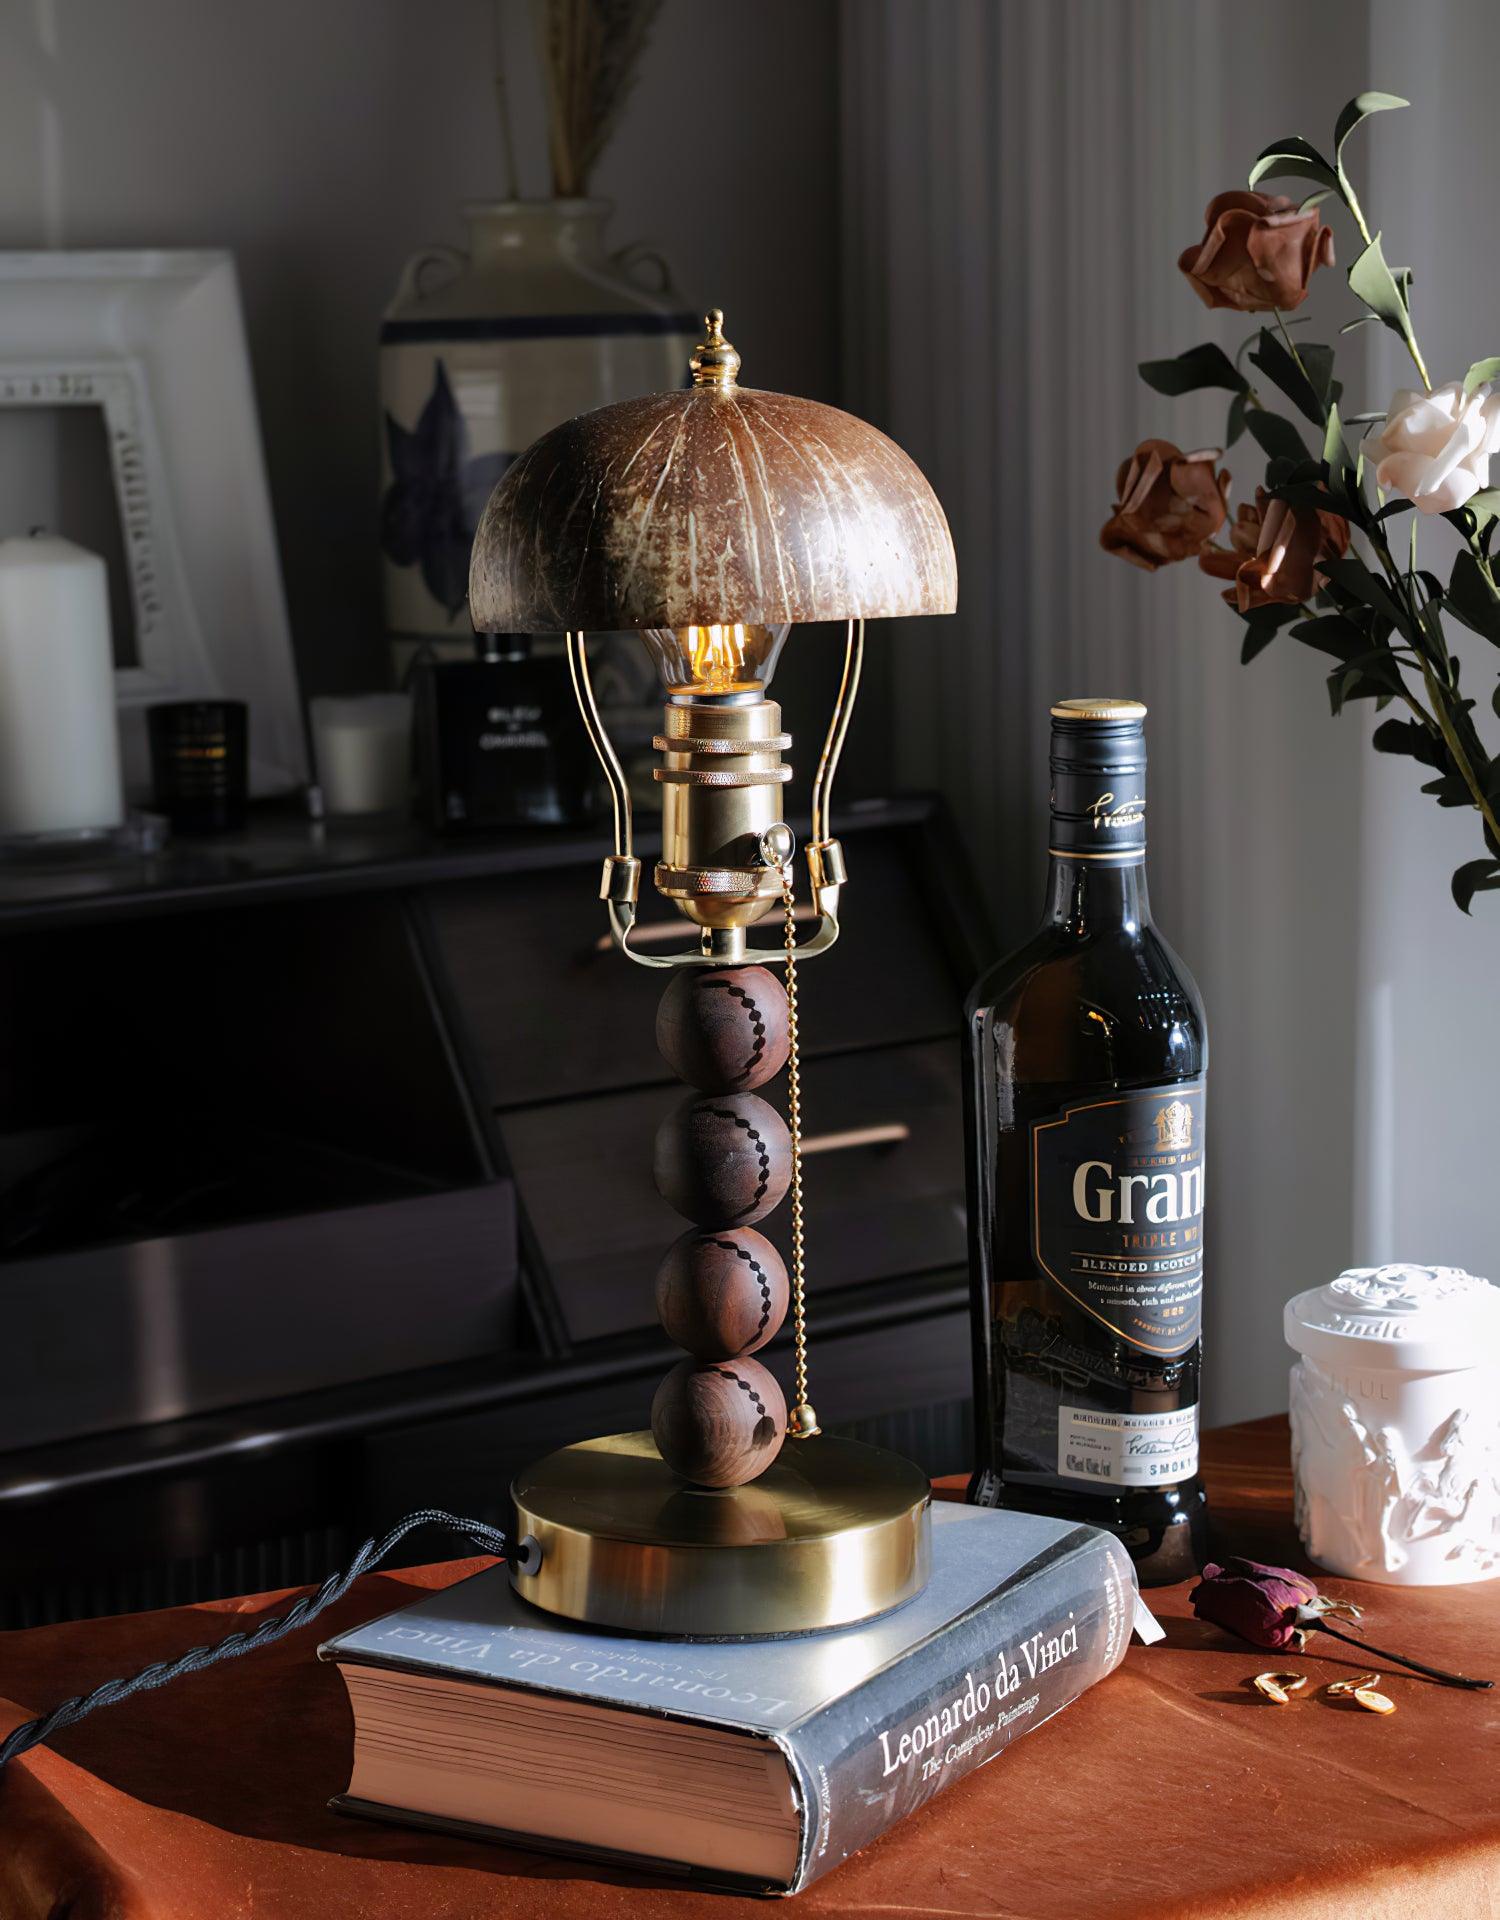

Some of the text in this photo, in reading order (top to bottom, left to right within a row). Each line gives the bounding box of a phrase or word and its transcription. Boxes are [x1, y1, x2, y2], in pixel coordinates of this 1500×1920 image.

[1122, 1231, 1176, 1248] TRIPLE
[1081, 1253, 1196, 1272] BLENDED SCOTCH
[376, 1627, 493, 1658] Vinci
[569, 1660, 793, 1715] Leonardo
[877, 1612, 1079, 1777] Leonardo da Vinci
[921, 1755, 944, 1781] The
